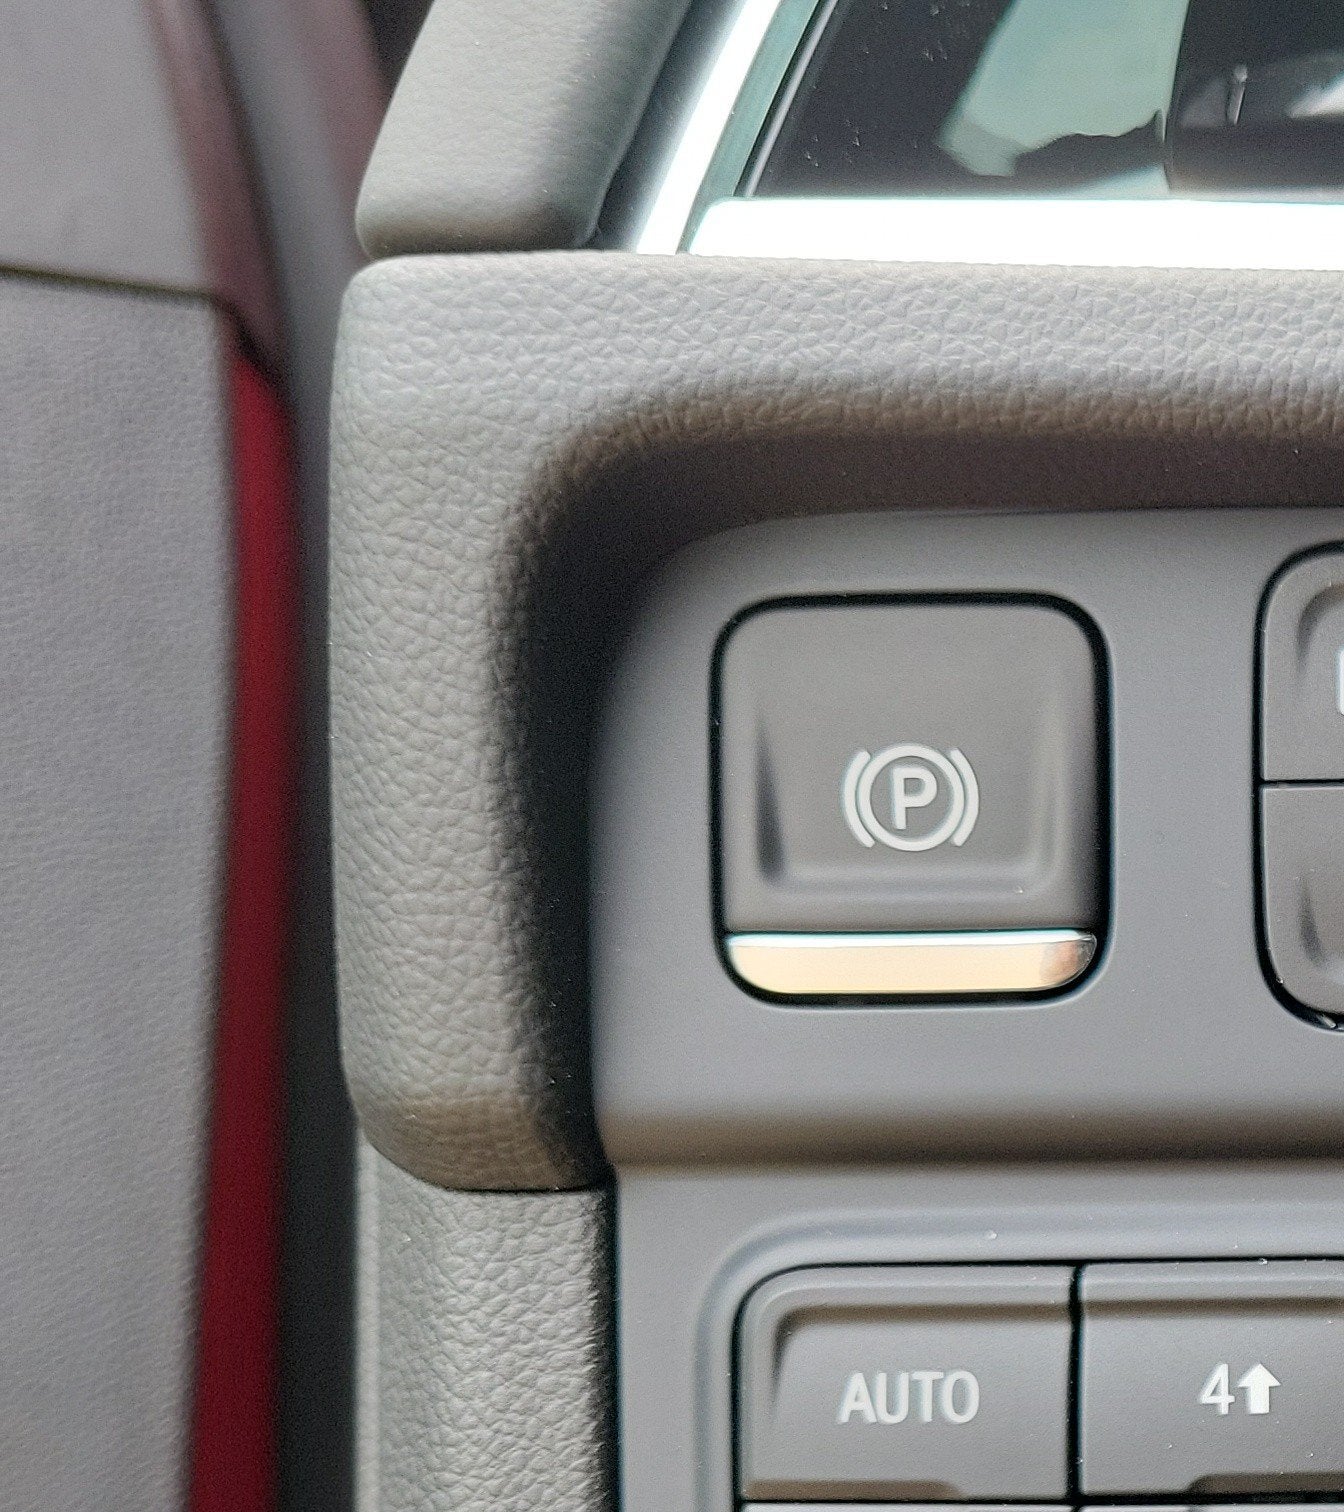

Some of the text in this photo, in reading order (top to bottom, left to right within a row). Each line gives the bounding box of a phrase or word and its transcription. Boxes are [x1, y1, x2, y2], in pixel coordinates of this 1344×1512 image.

[892, 766, 937, 829] P
[837, 1369, 981, 1425] AUTO
[1199, 1364, 1235, 1416] 4
